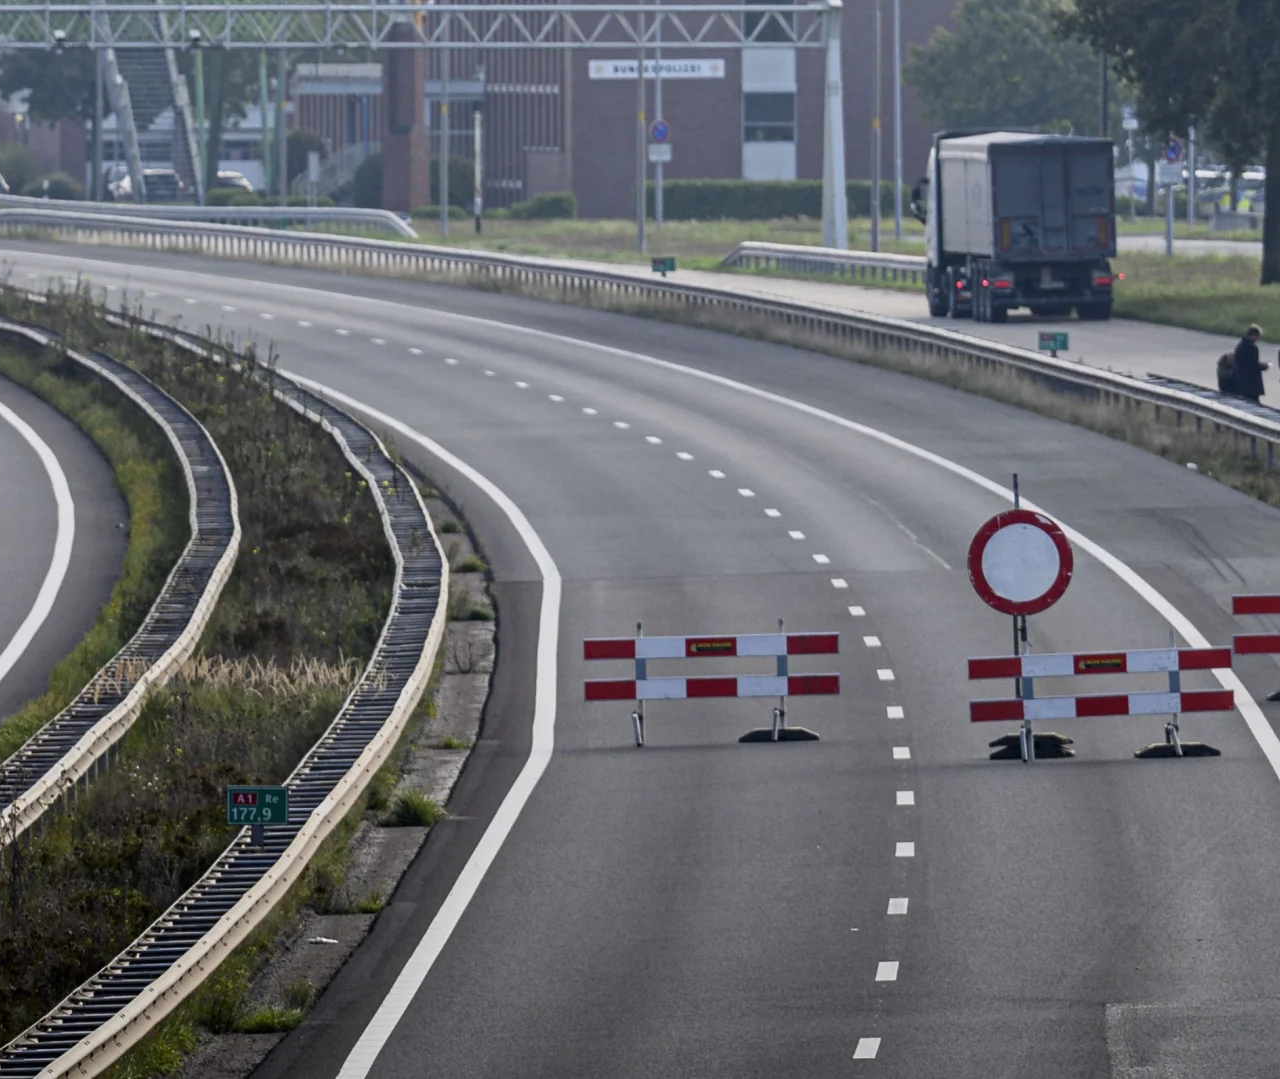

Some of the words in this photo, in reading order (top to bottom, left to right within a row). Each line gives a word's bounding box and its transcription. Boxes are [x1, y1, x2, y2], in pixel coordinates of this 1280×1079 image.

[237, 794, 253, 803] A1
[265, 794, 279, 804] Re
[231, 807, 272, 822] 177,9
